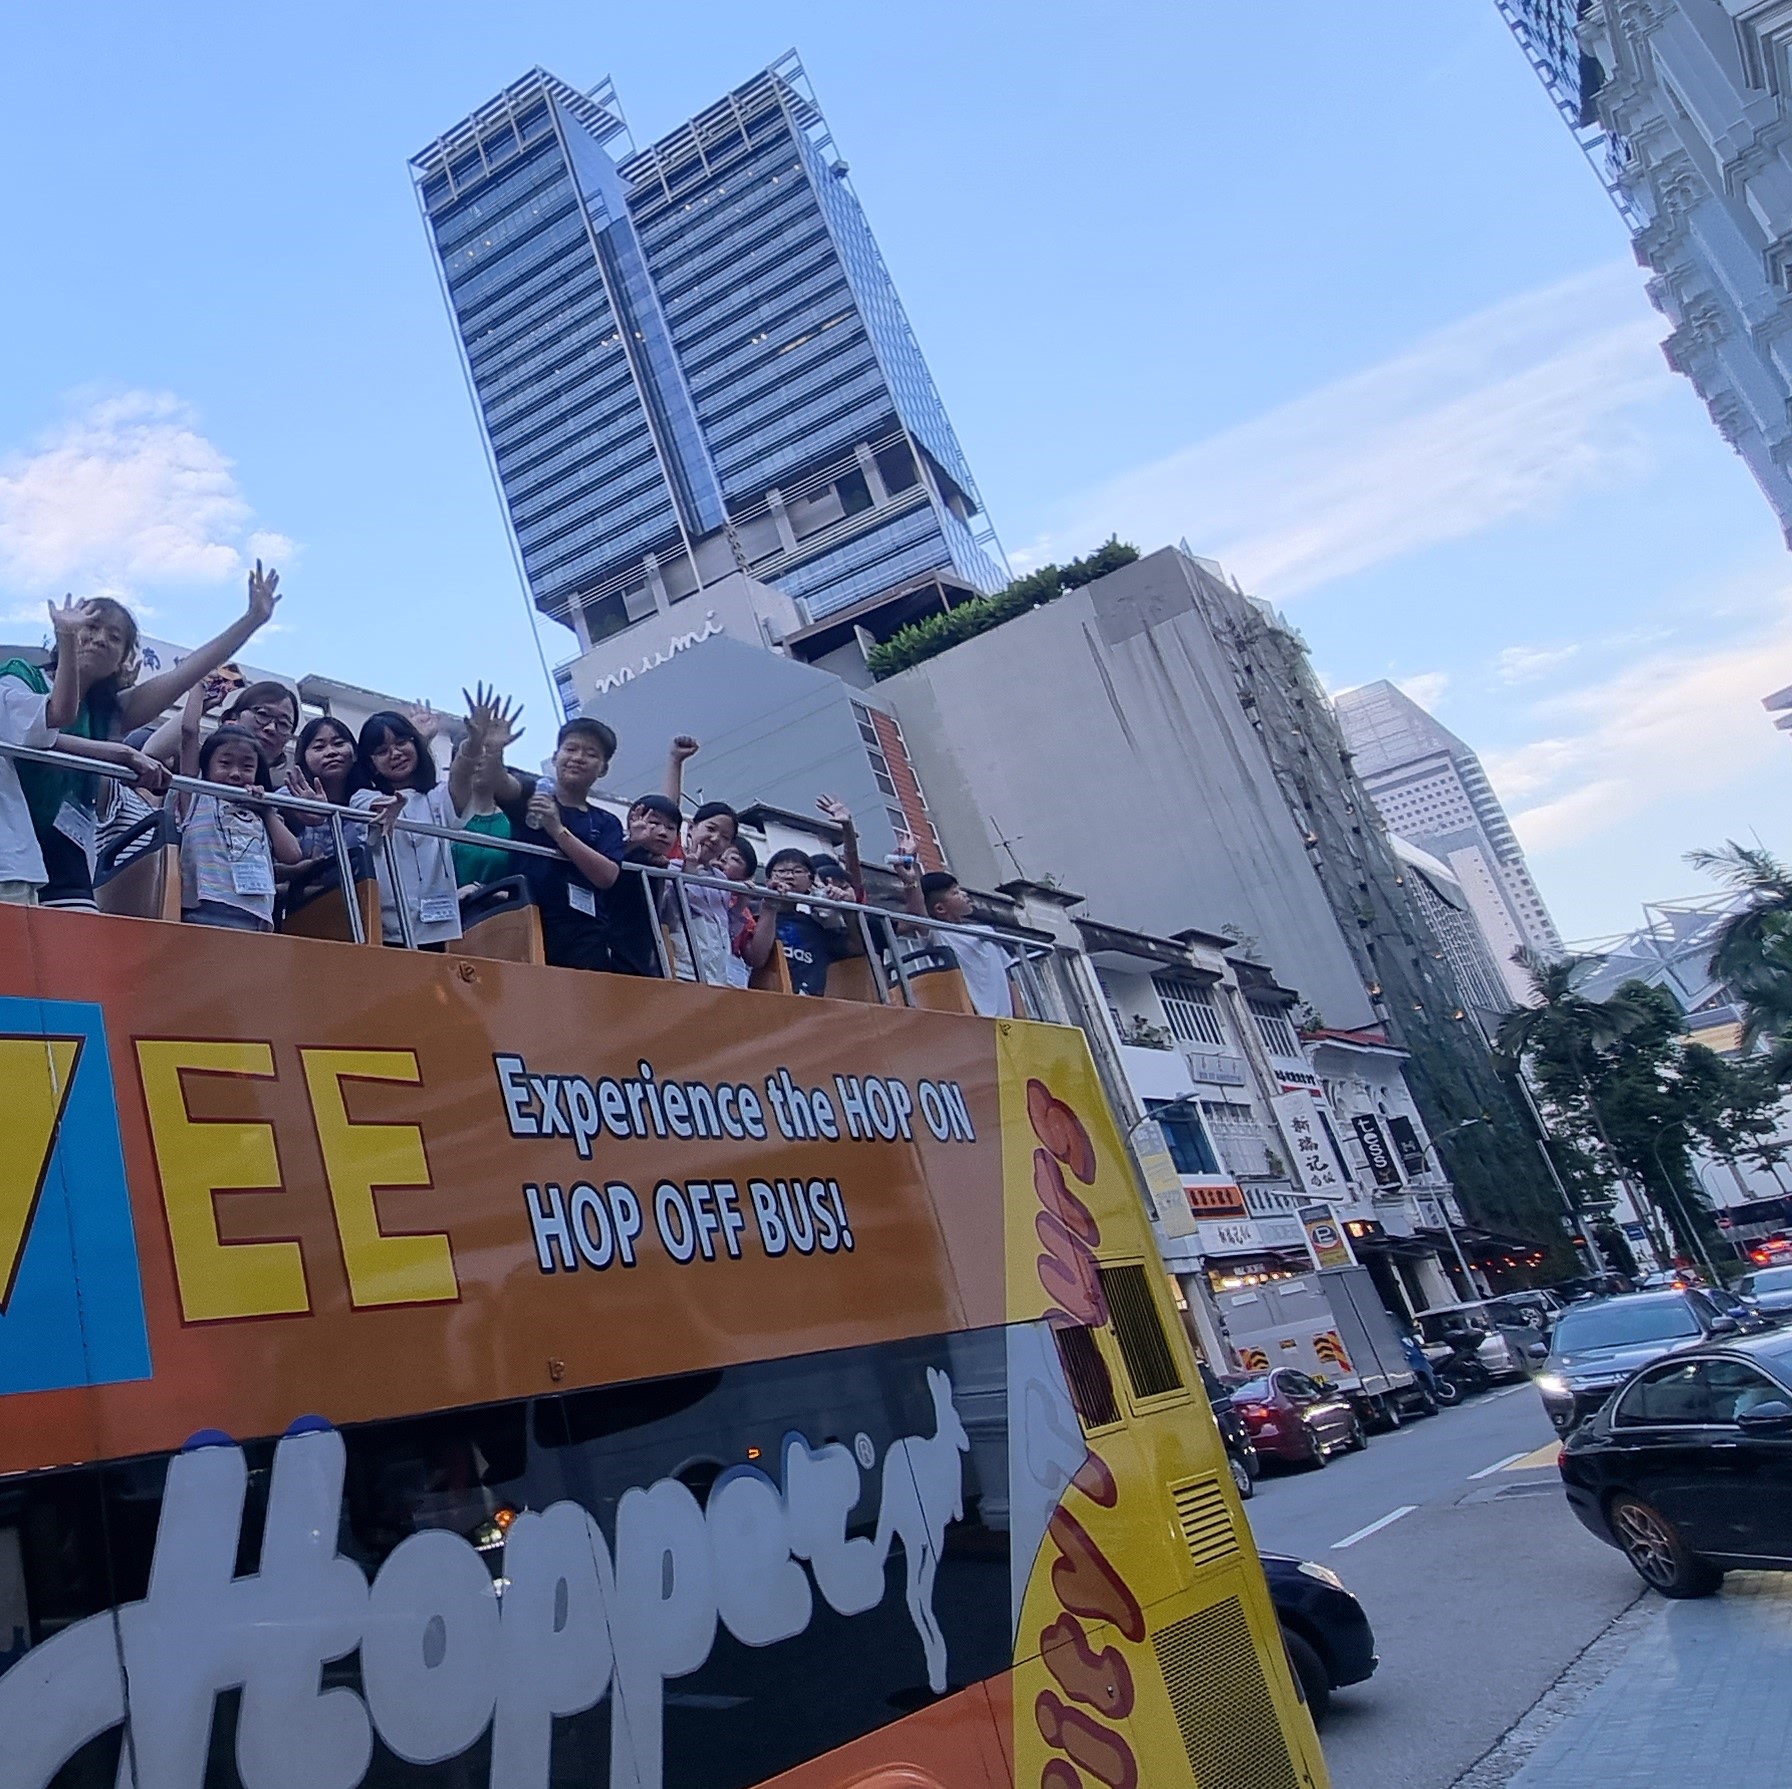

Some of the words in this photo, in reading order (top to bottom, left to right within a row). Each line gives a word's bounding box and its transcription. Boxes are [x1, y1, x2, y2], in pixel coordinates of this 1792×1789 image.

[493, 1052, 767, 1160] Experience
[765, 1067, 840, 1141] the
[834, 1074, 914, 1142] HOP
[916, 1080, 977, 1143] ON
[1358, 1119, 1388, 1168] tess
[523, 1179, 643, 1274] HOP
[653, 1178, 745, 1265] OFF
[748, 1177, 855, 1259] BUS!
